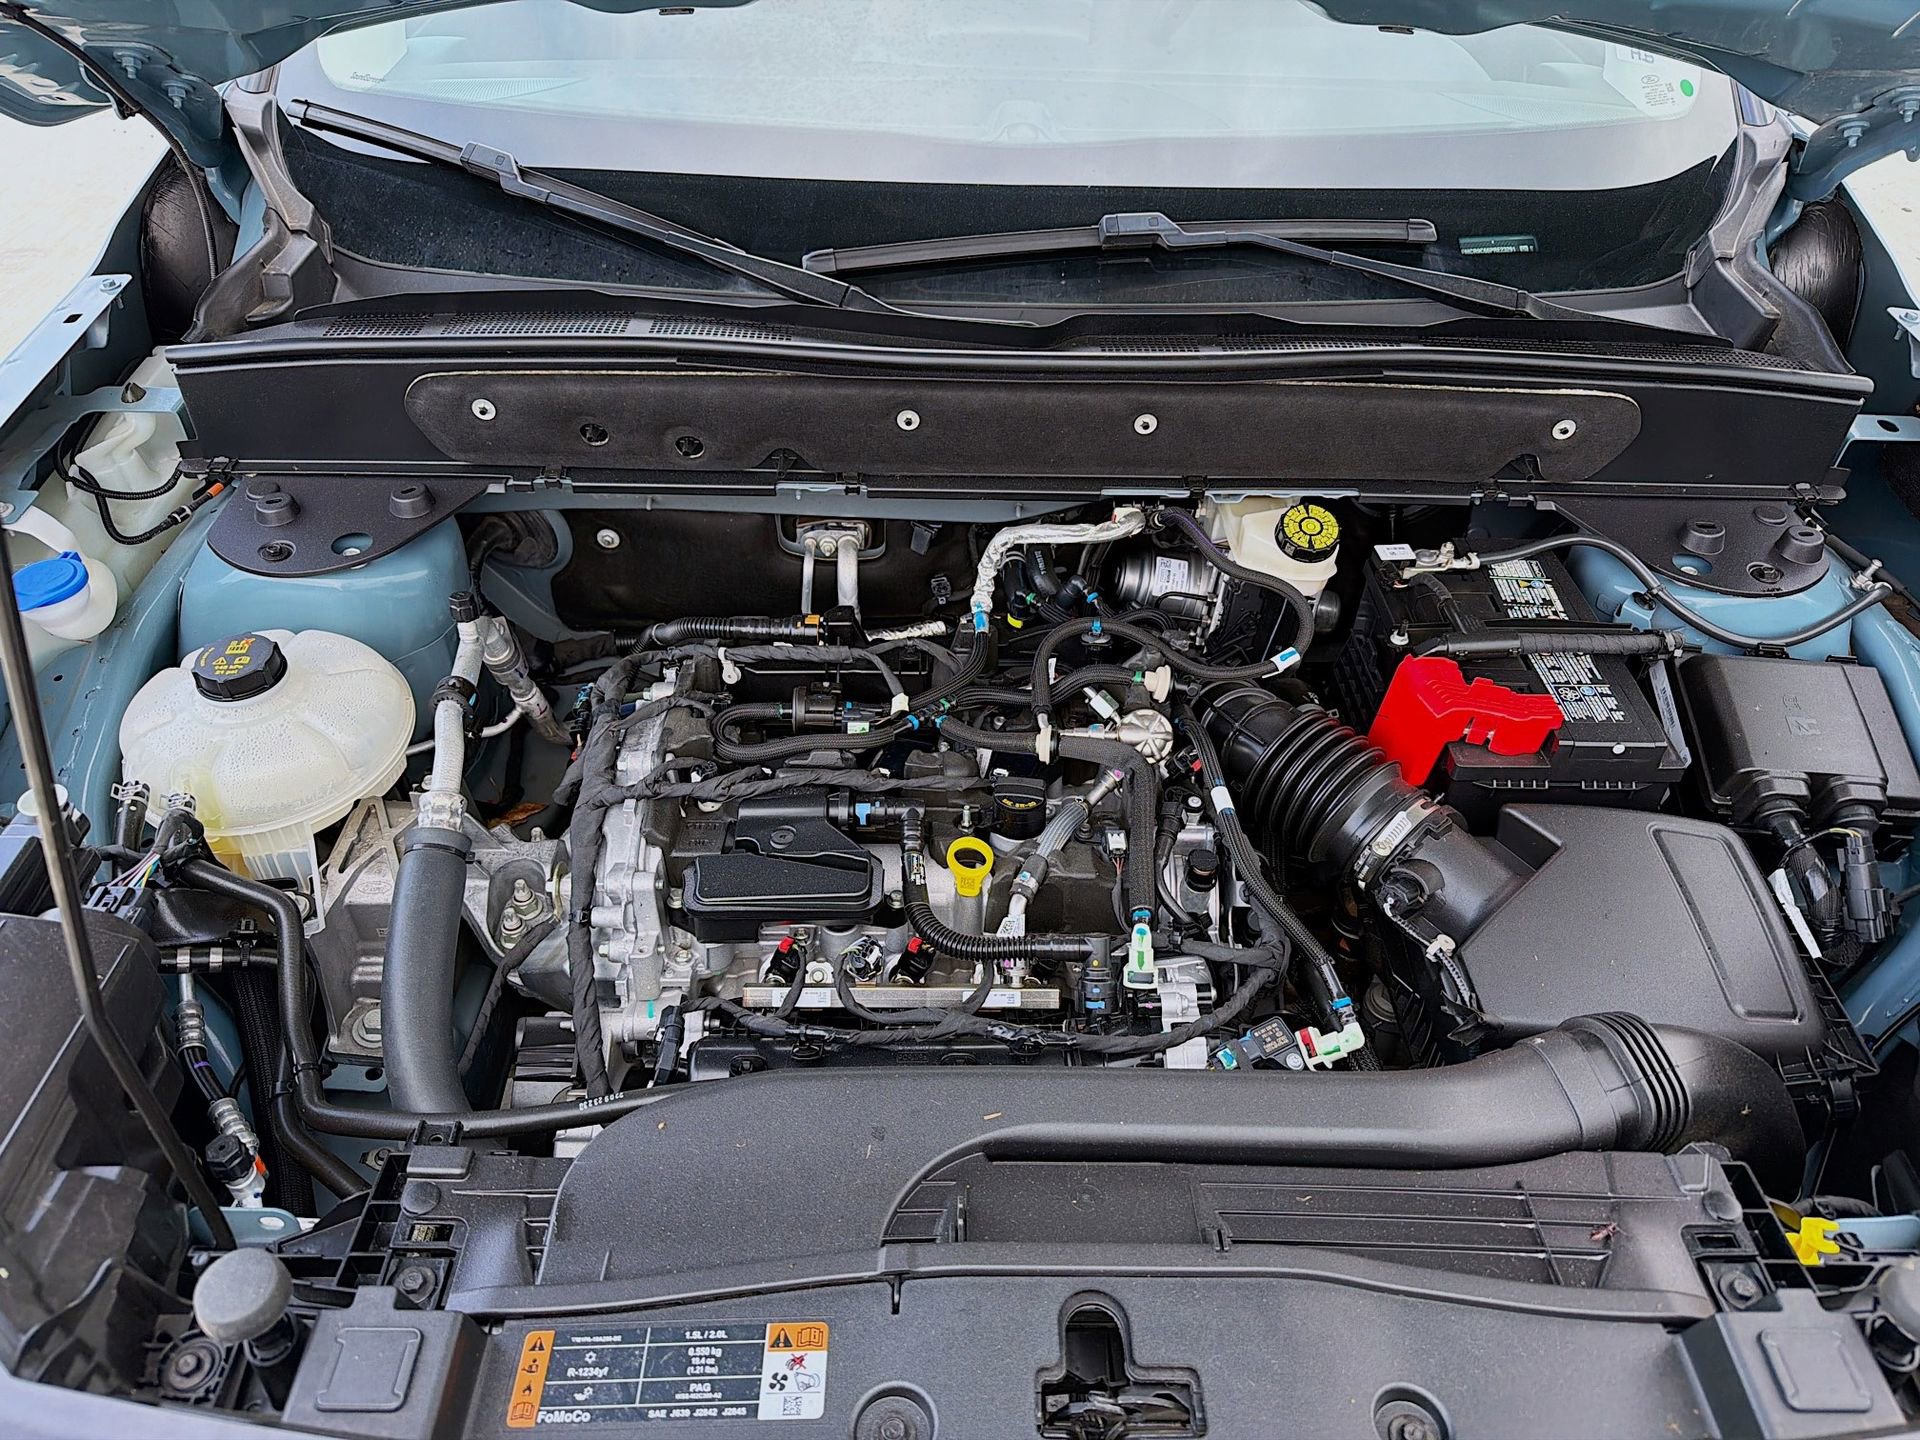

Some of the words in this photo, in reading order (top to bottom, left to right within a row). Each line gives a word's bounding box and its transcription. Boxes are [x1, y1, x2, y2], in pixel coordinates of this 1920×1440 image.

[685, 1331, 703, 1339] 1.5L
[709, 1330, 728, 1338] 2.0L
[688, 1347, 710, 1356] 0.550
[711, 1347, 722, 1357] kg
[566, 1366, 609, 1378] R-1234yf
[689, 1383, 711, 1392] PAG
[536, 1410, 591, 1424] FoMoCo
[648, 1409, 667, 1418] SAE
